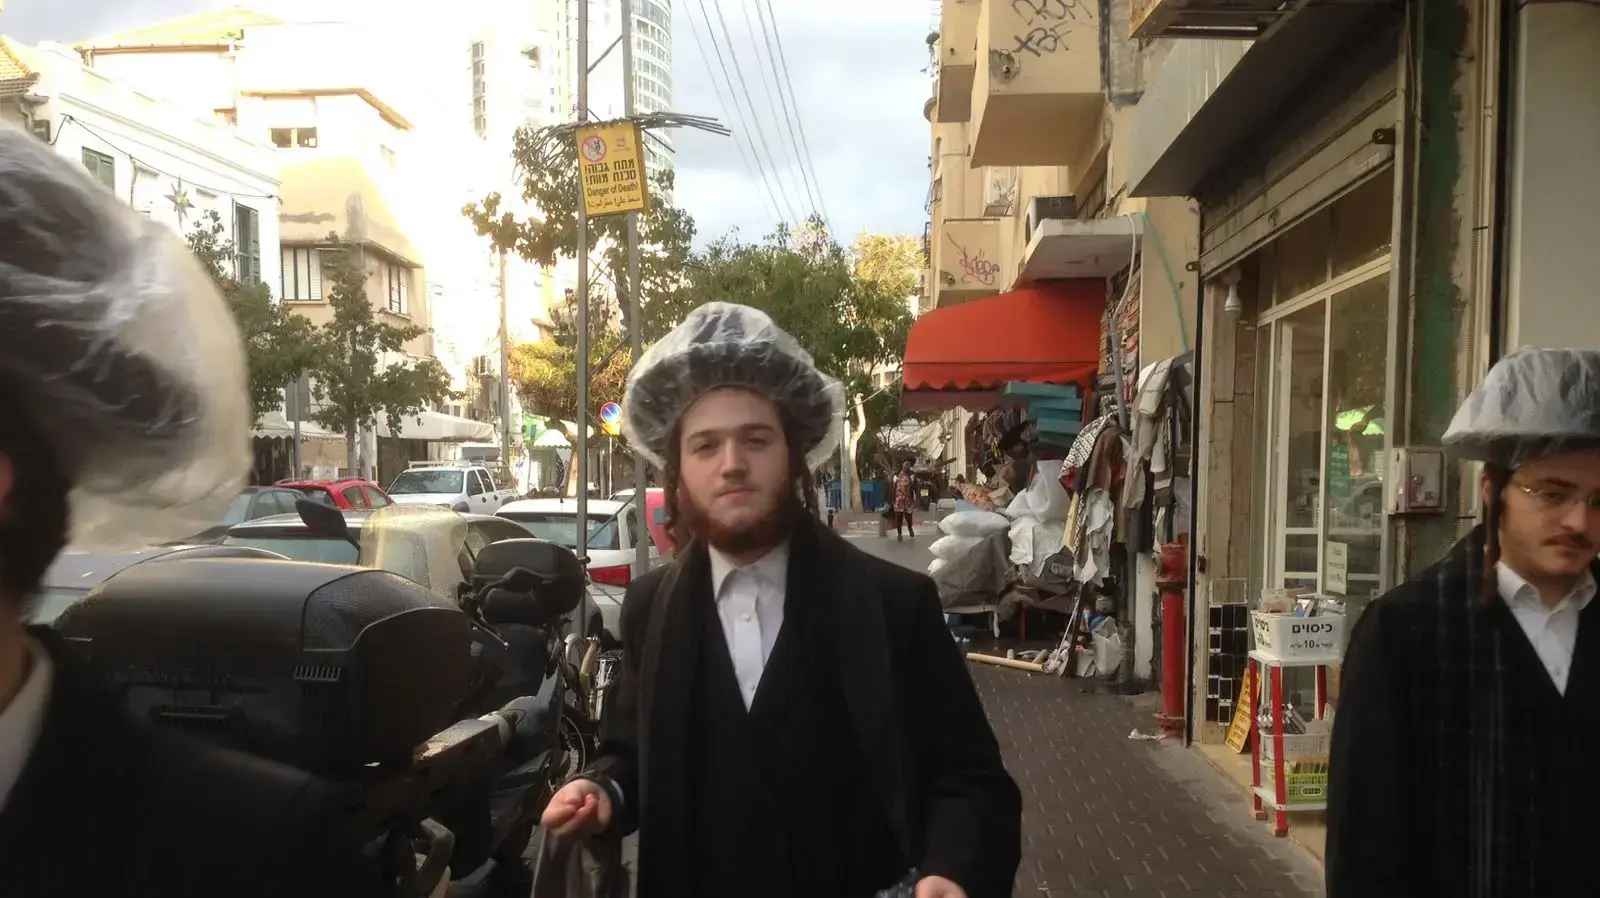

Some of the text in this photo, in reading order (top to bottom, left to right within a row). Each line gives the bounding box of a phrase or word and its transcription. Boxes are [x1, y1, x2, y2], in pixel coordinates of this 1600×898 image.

[587, 182, 637, 197] Danger of Death!
[1304, 639, 1315, 649] 10
